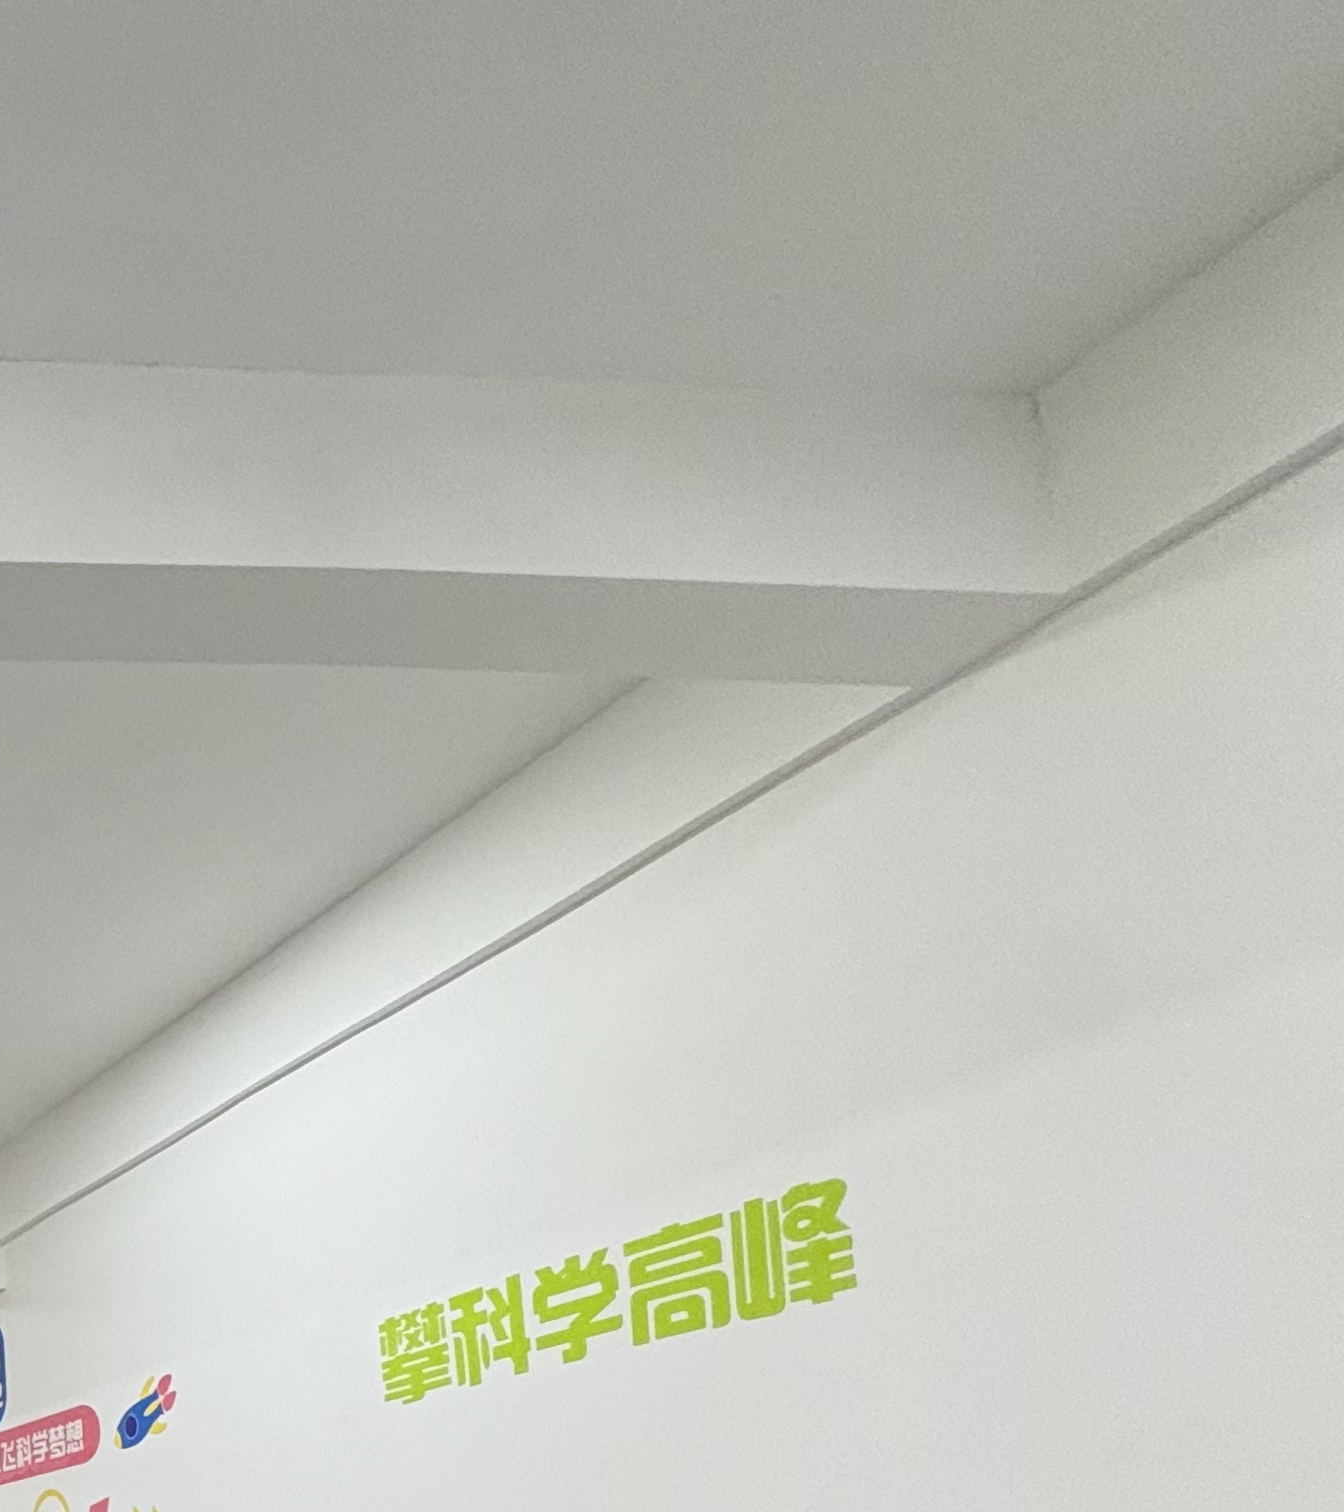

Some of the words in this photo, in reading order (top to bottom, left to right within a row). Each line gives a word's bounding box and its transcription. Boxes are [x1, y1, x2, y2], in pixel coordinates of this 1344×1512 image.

[378, 1177, 858, 1405] 攀科学高峰
